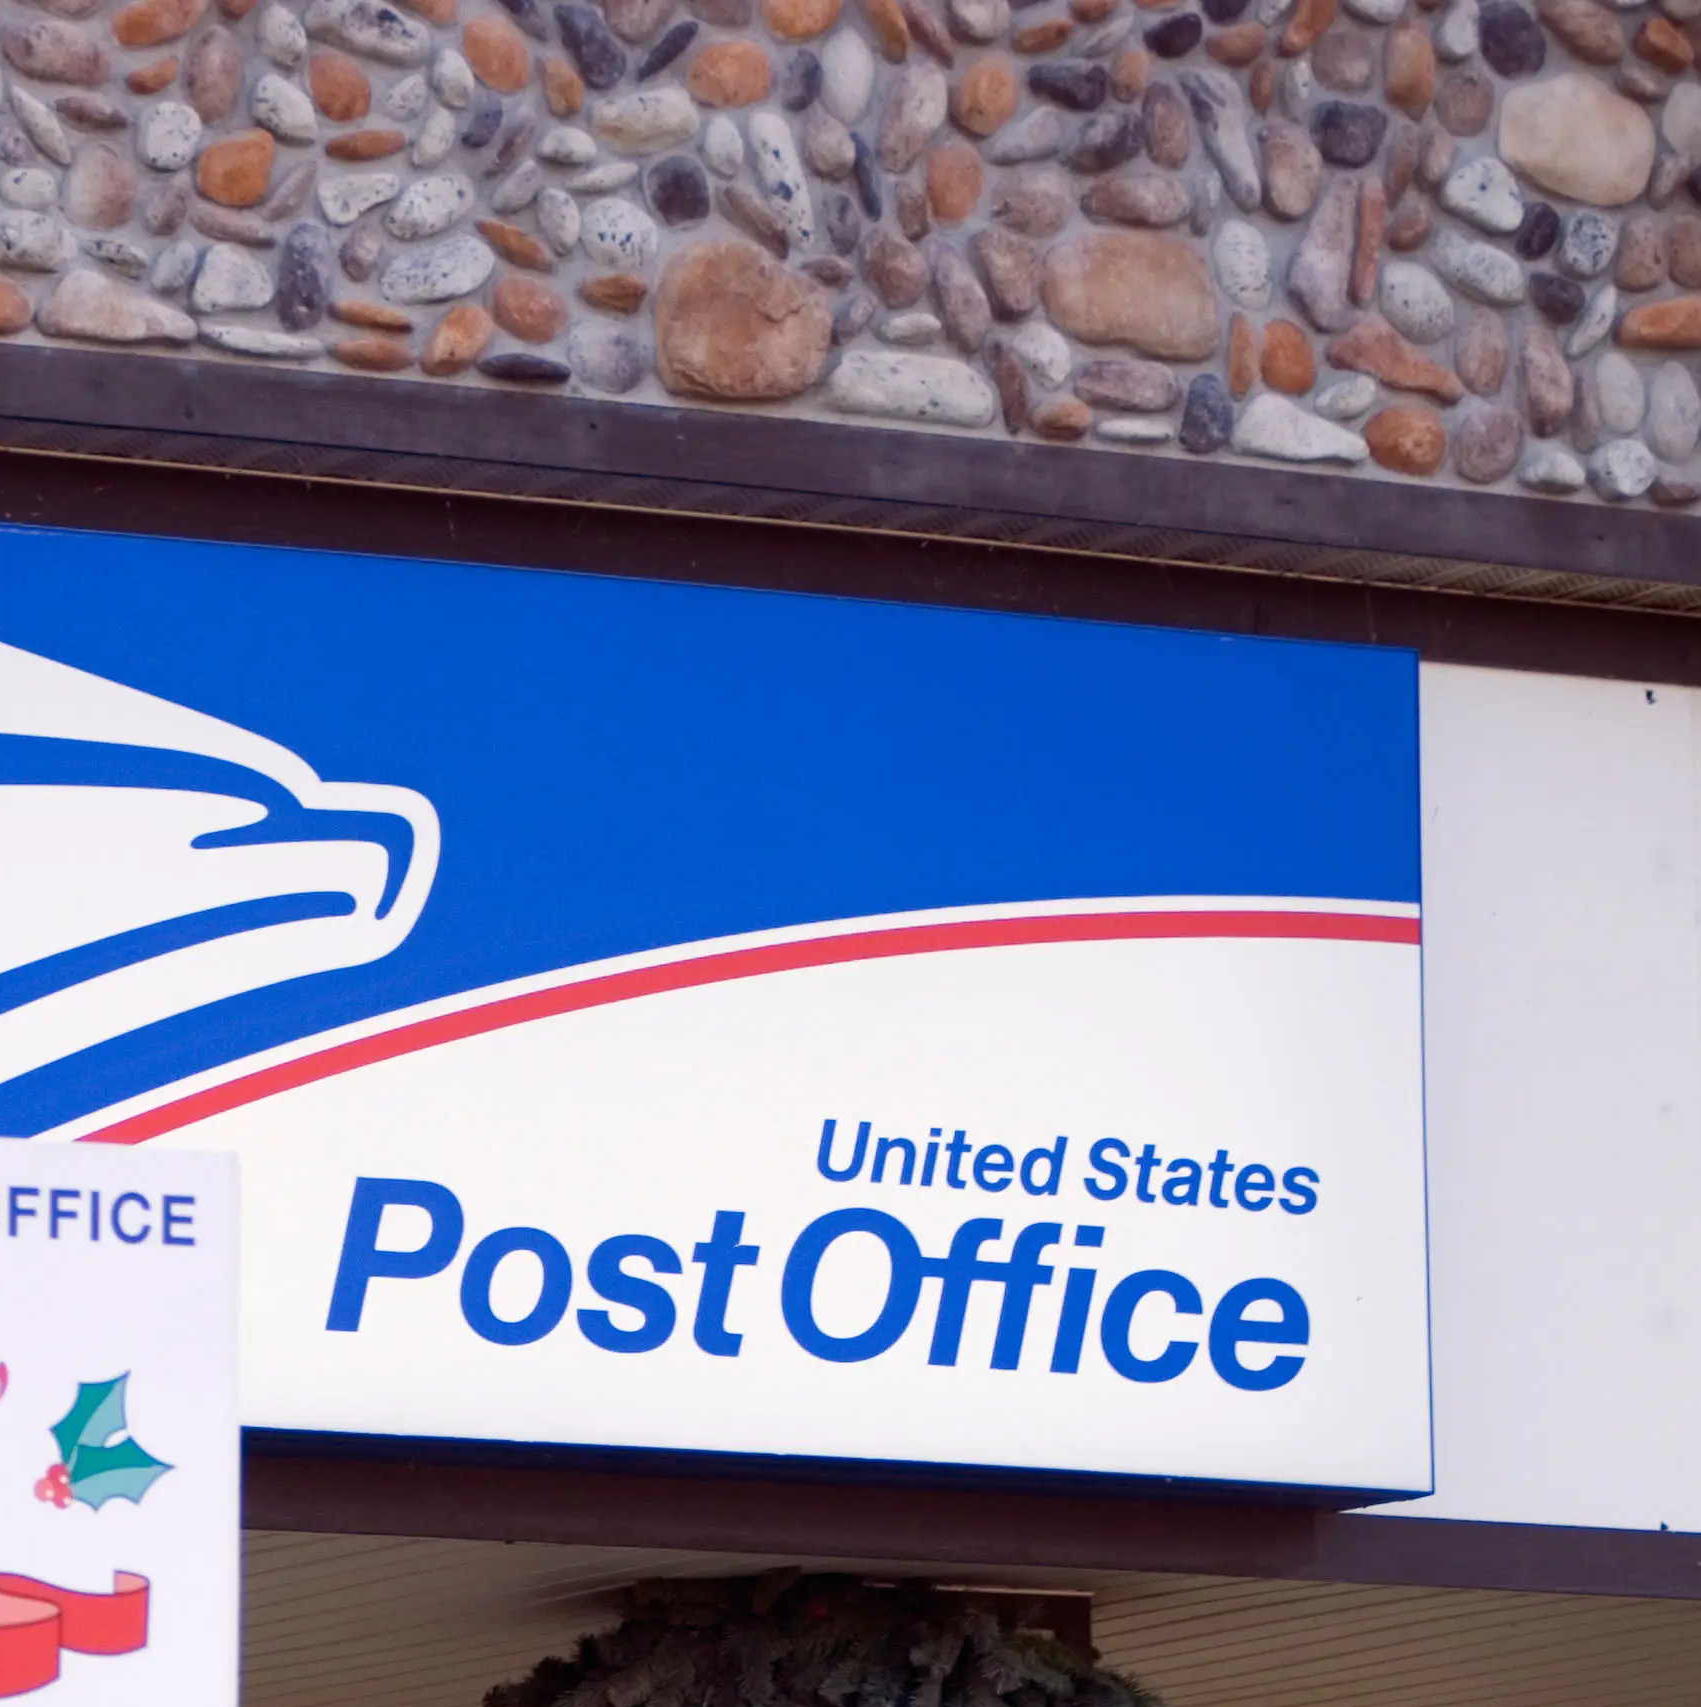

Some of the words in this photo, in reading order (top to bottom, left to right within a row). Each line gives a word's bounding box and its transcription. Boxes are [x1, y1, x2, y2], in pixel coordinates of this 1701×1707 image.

[816, 1118, 1070, 1197] United
[1083, 1137, 1322, 1215] States
[325, 1175, 760, 1357] Post
[781, 1206, 1311, 1392] Office
